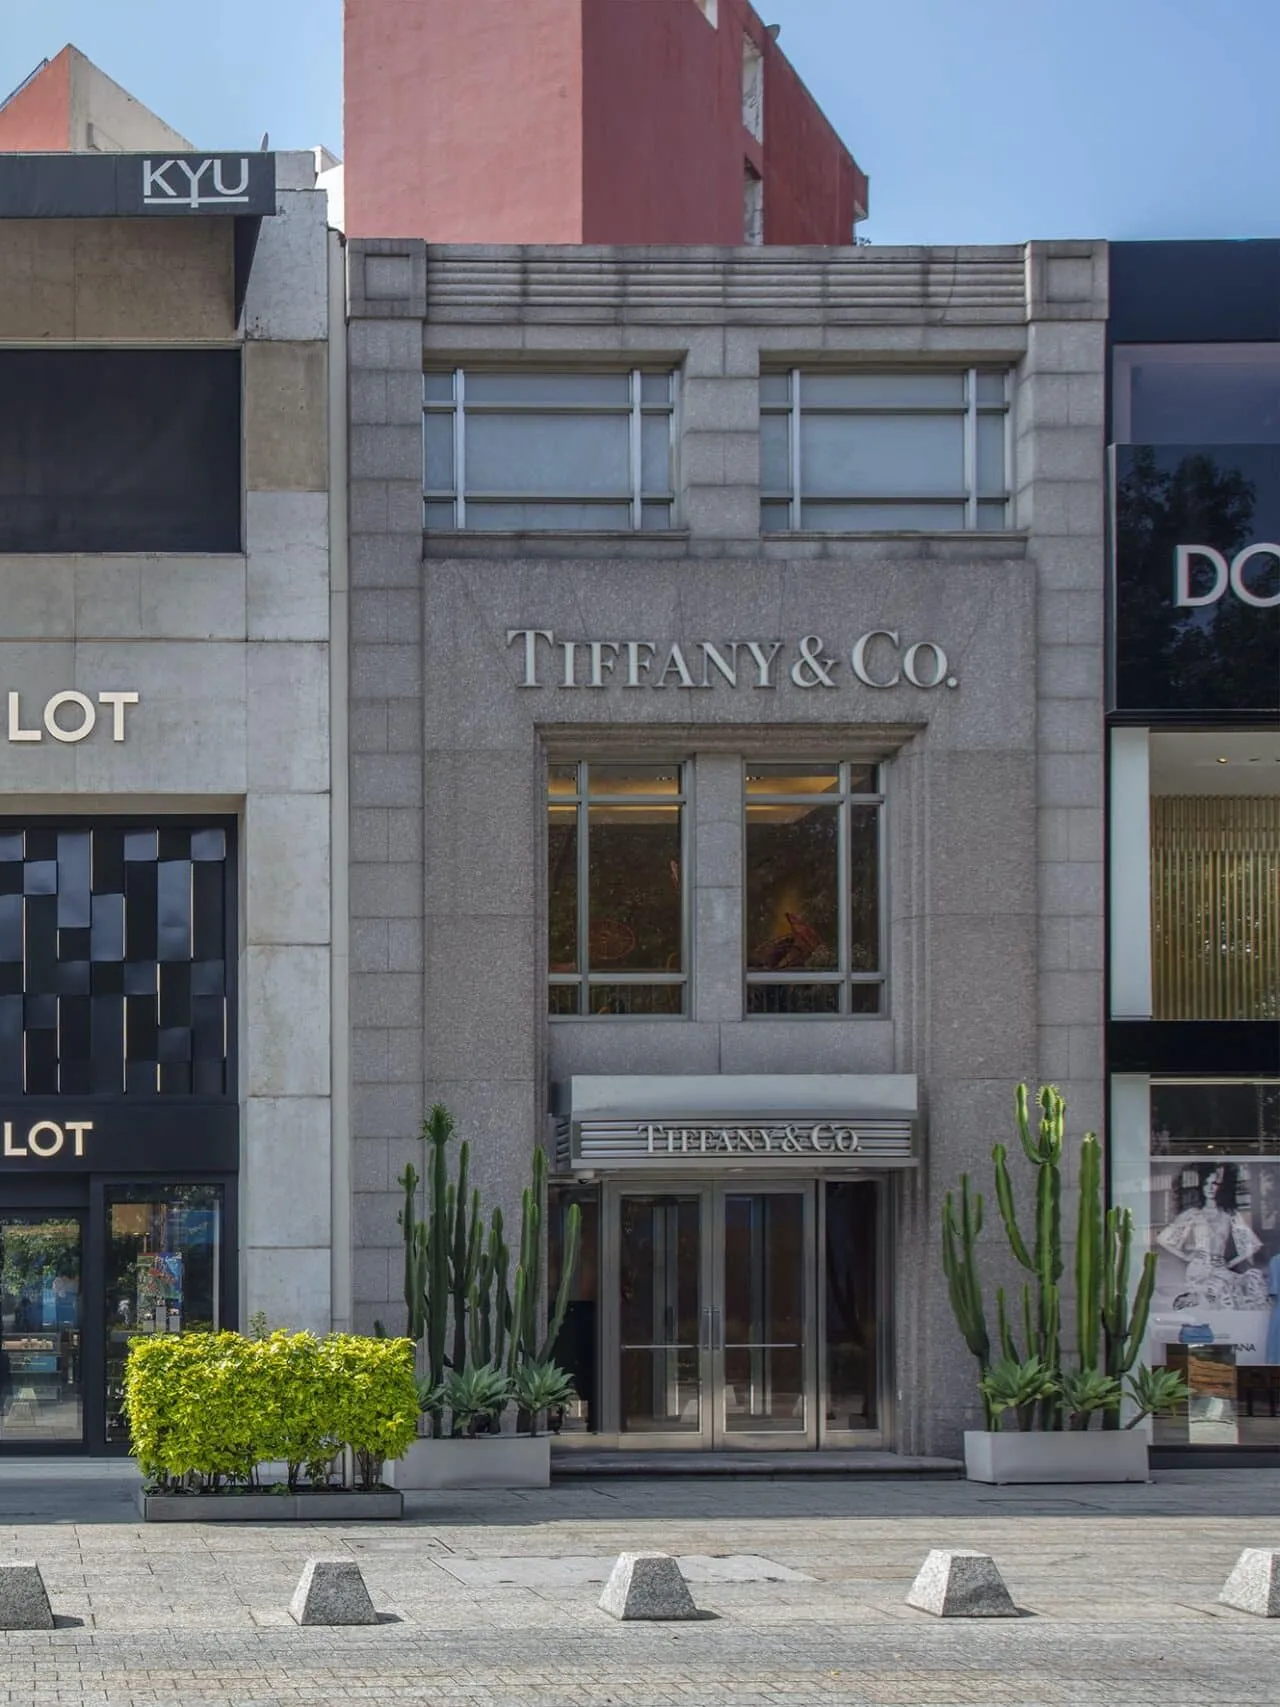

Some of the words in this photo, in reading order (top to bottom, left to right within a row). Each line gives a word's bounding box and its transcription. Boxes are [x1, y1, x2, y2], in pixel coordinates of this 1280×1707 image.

[142, 157, 249, 208] KYU
[507, 629, 784, 689] TIFFANY
[637, 1123, 773, 1153] TIFFANY
